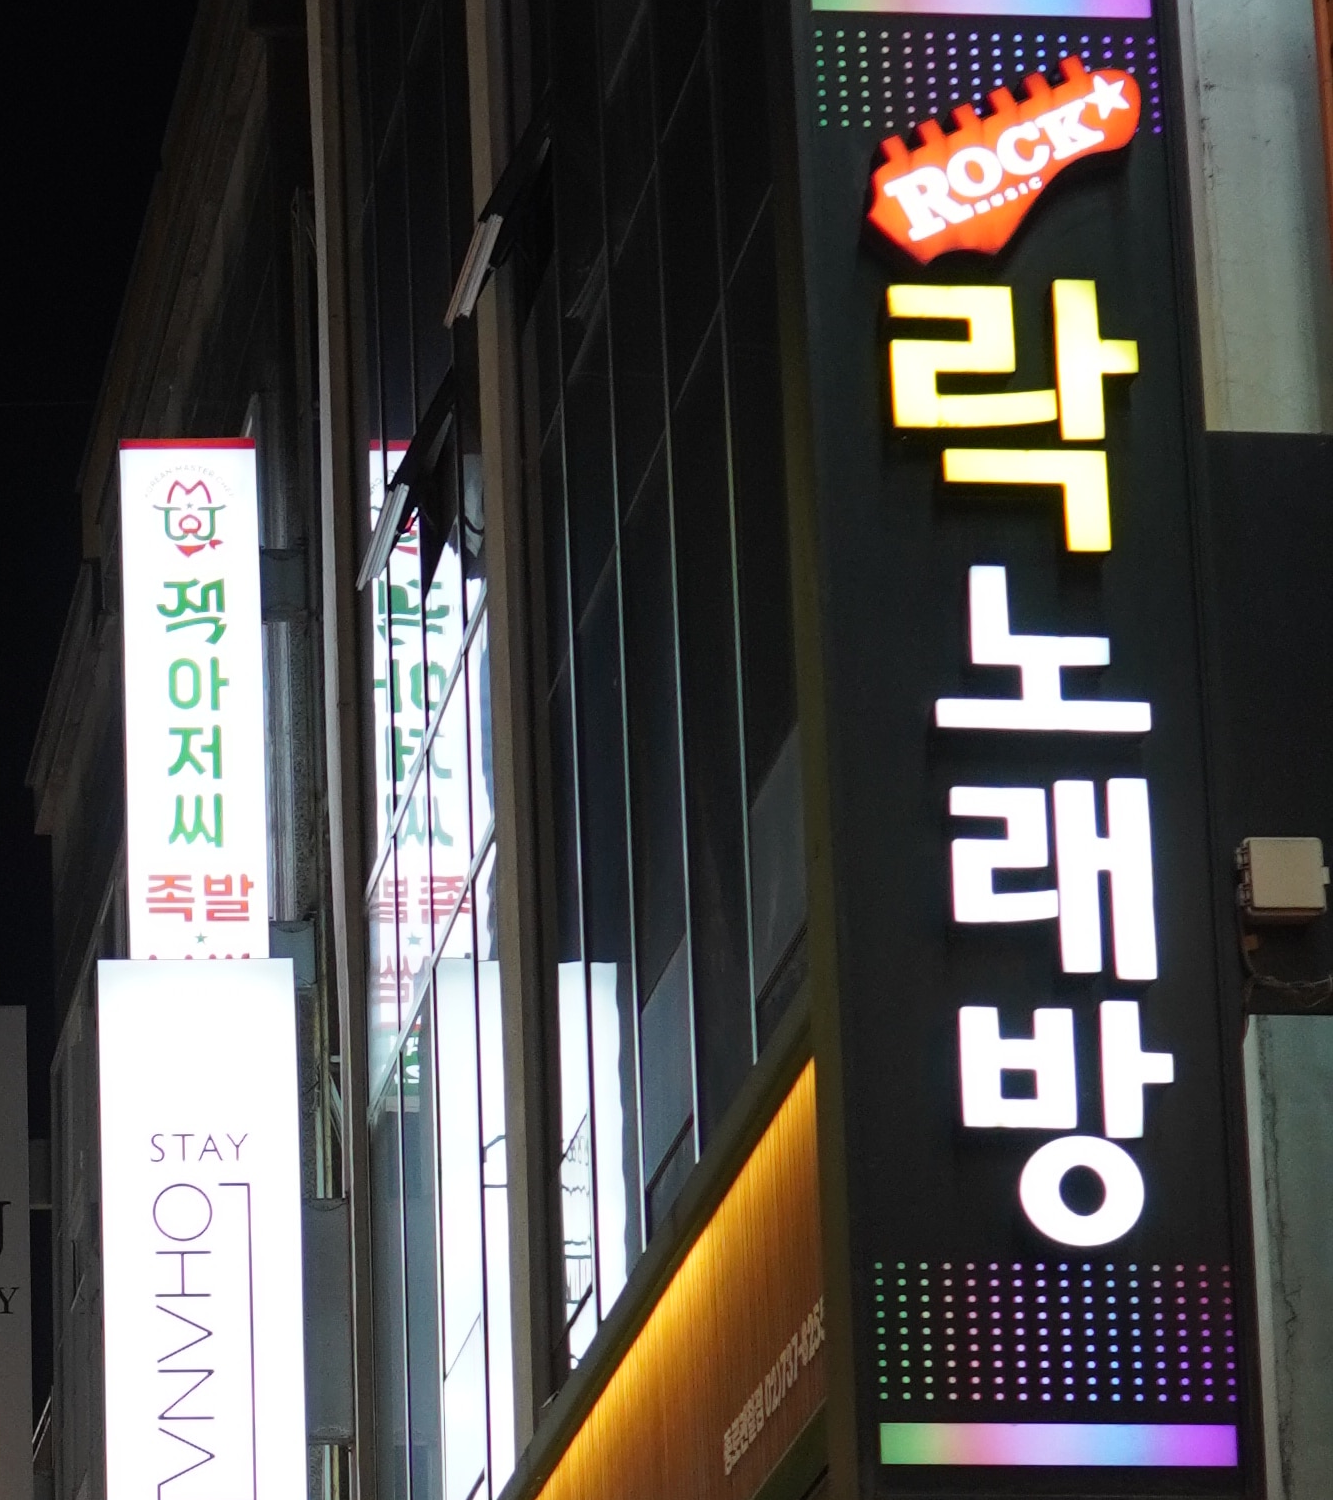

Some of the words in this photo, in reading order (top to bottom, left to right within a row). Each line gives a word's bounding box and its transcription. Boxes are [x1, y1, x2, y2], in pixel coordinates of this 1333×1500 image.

[883, 98, 1105, 242] ROCK
[145, 872, 250, 924] 족발
[150, 1132, 248, 1163] STAY
